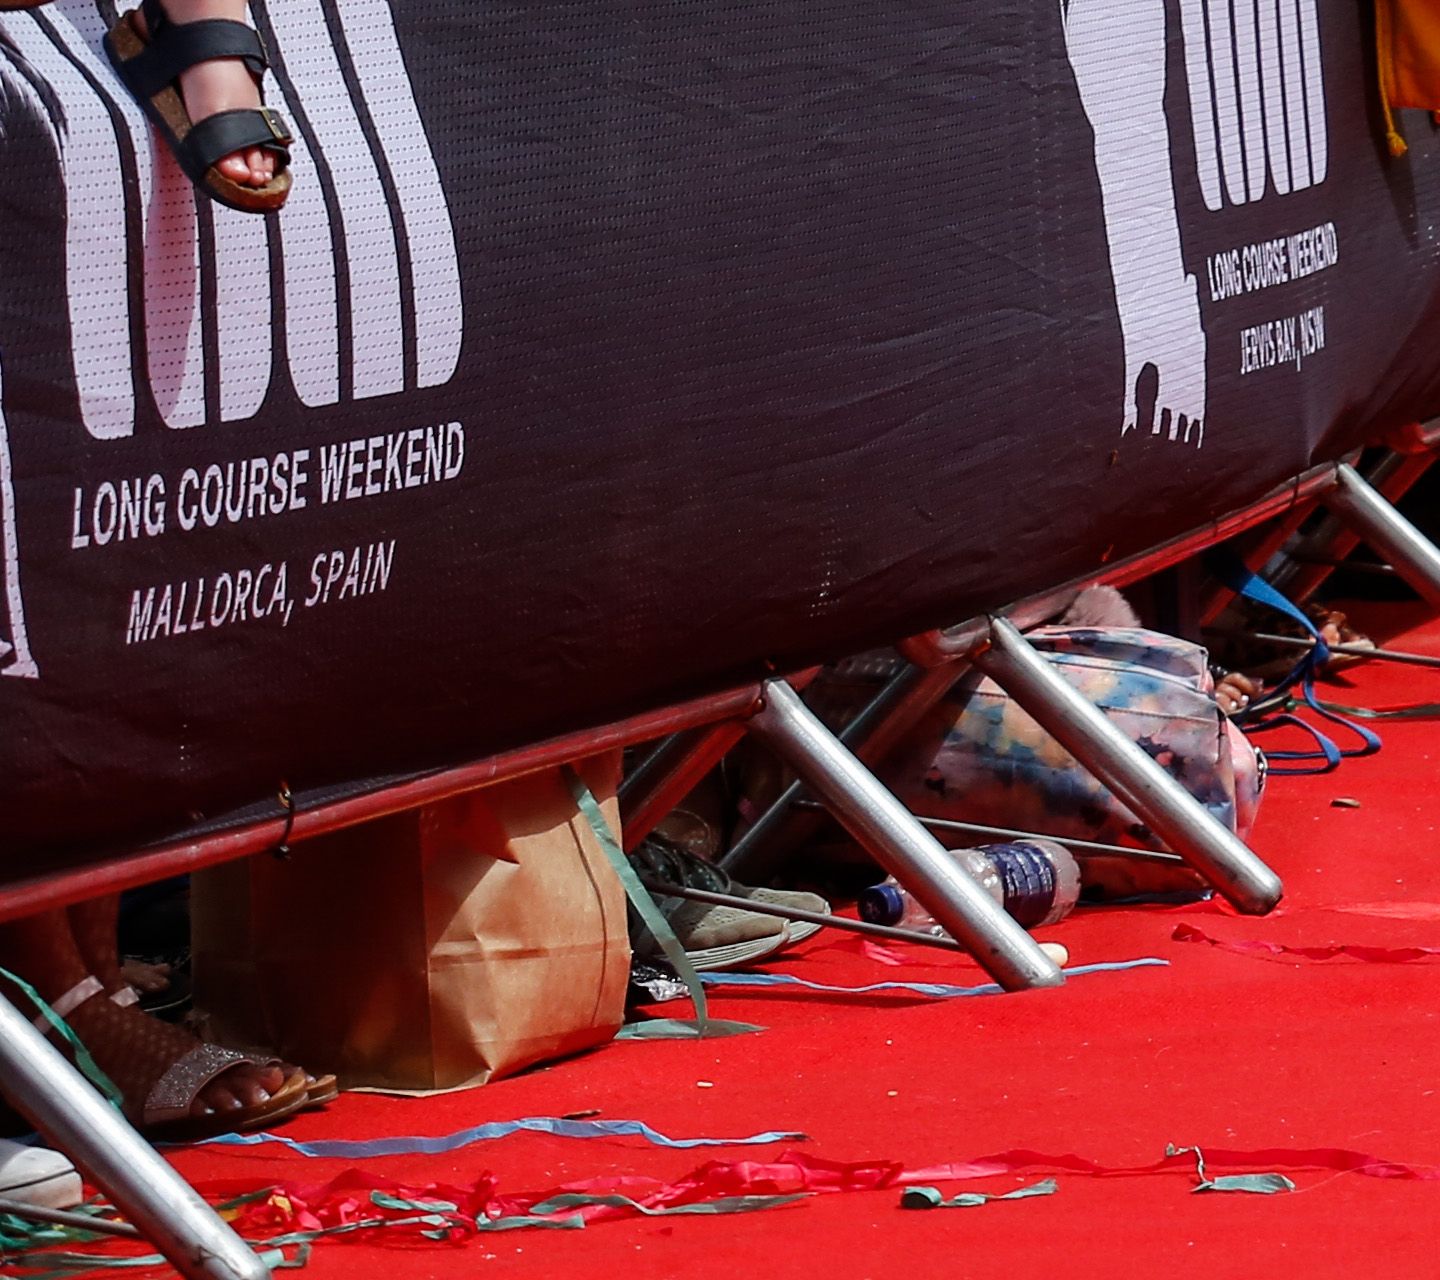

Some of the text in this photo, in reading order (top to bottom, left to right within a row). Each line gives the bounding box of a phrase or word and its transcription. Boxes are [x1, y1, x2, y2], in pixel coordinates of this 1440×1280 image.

[1206, 221, 1339, 302] LONG COURSE WEEKEND
[1239, 305, 1326, 375] JERVIS BAY, NSW
[71, 420, 466, 550] LONG COURSE WEEKEND
[125, 538, 398, 646] MALLORCA, SPAIN
